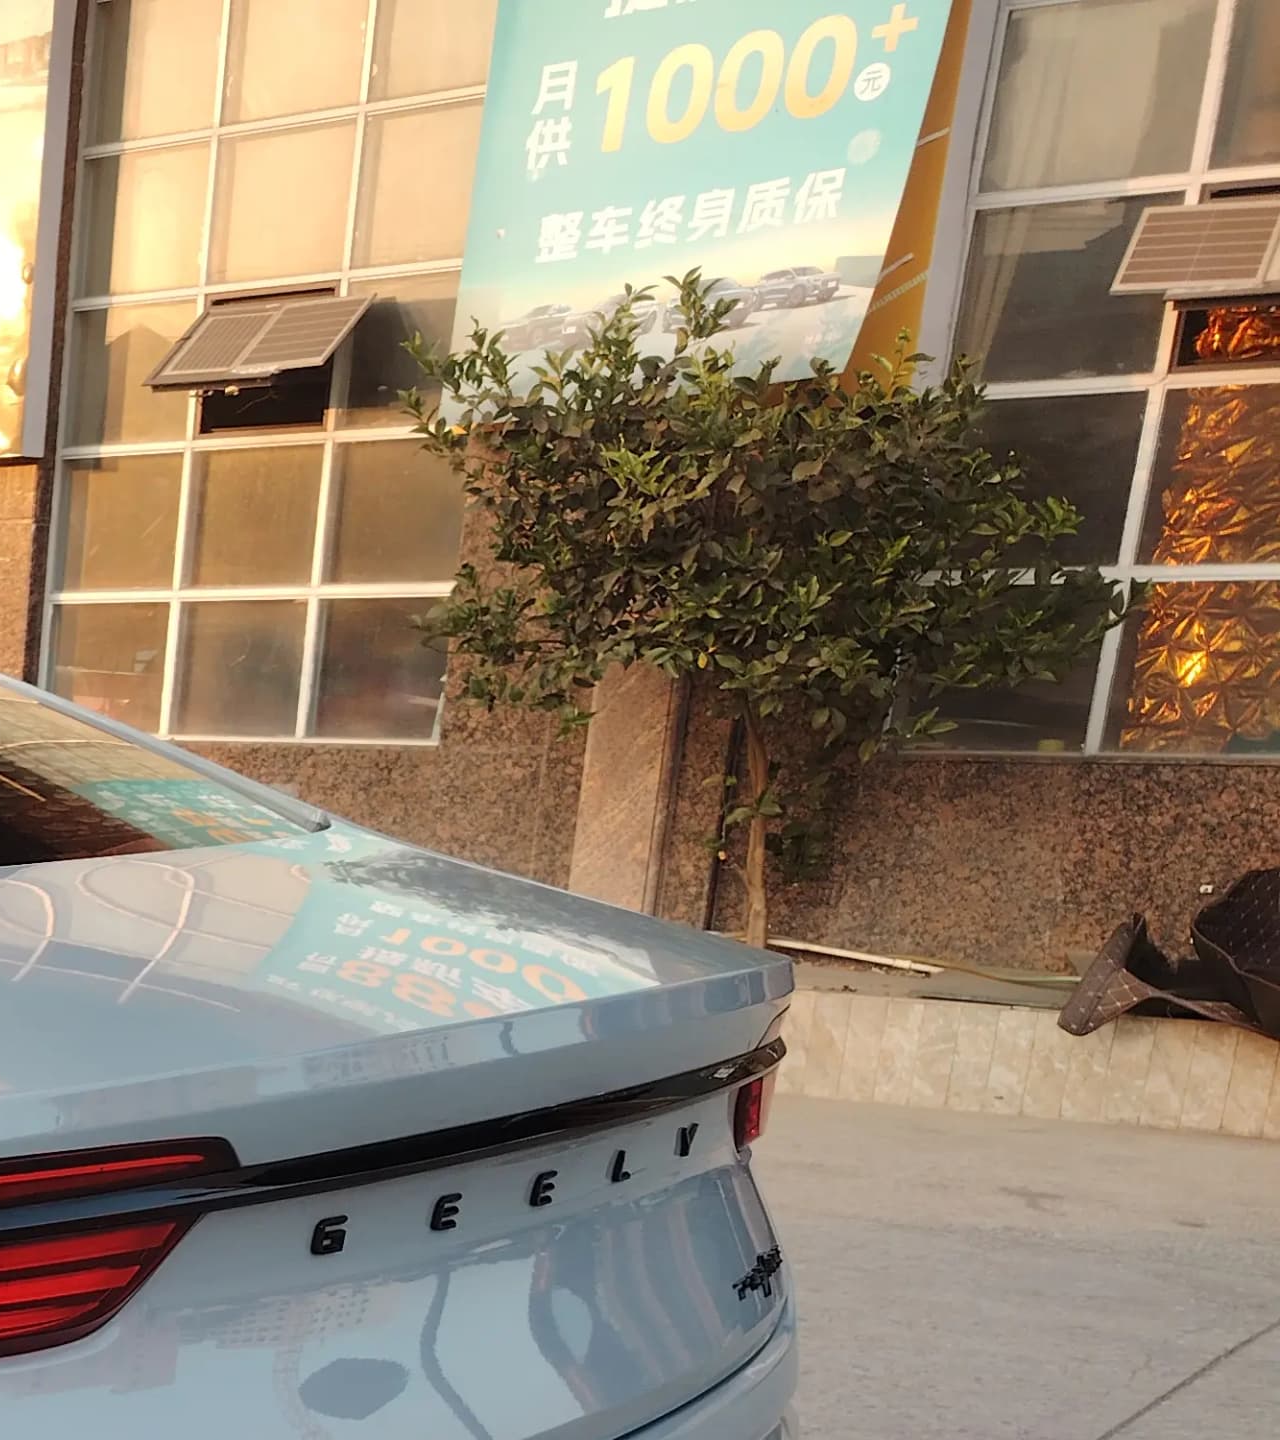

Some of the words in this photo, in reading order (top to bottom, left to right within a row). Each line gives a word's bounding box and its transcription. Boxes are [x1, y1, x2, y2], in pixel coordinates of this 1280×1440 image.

[526, 60, 579, 174] 月供
[534, 166, 848, 264] 整车终身质保
[310, 1122, 700, 1256] GEELY
